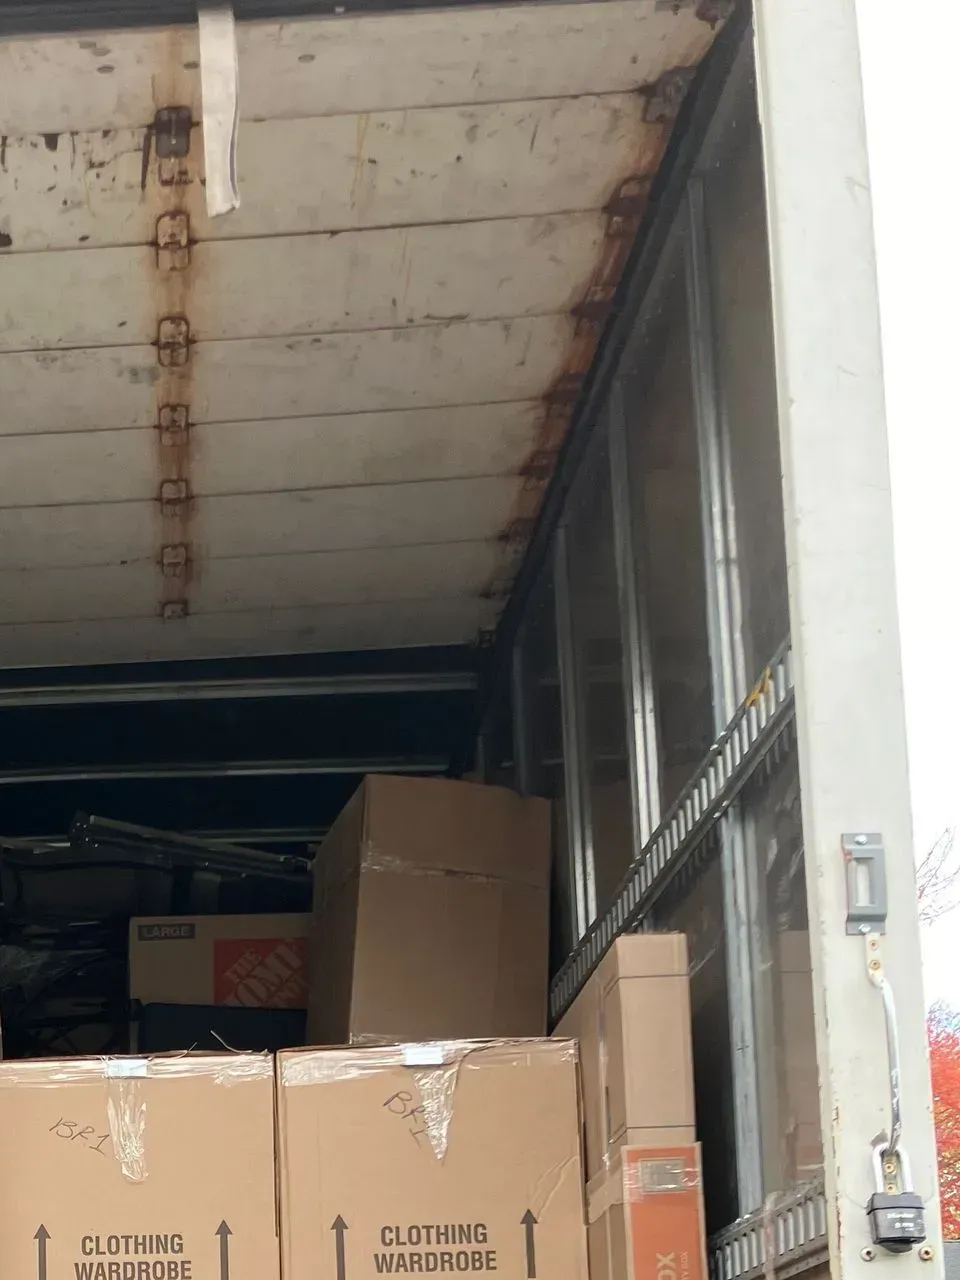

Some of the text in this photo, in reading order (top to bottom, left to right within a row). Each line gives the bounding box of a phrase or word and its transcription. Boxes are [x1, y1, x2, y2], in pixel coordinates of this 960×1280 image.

[142, 925, 191, 938] LARGE
[81, 1233, 184, 1256] CLOTHING
[380, 1223, 487, 1247] CLOTHING
[373, 1250, 497, 1273] WARDROBE
